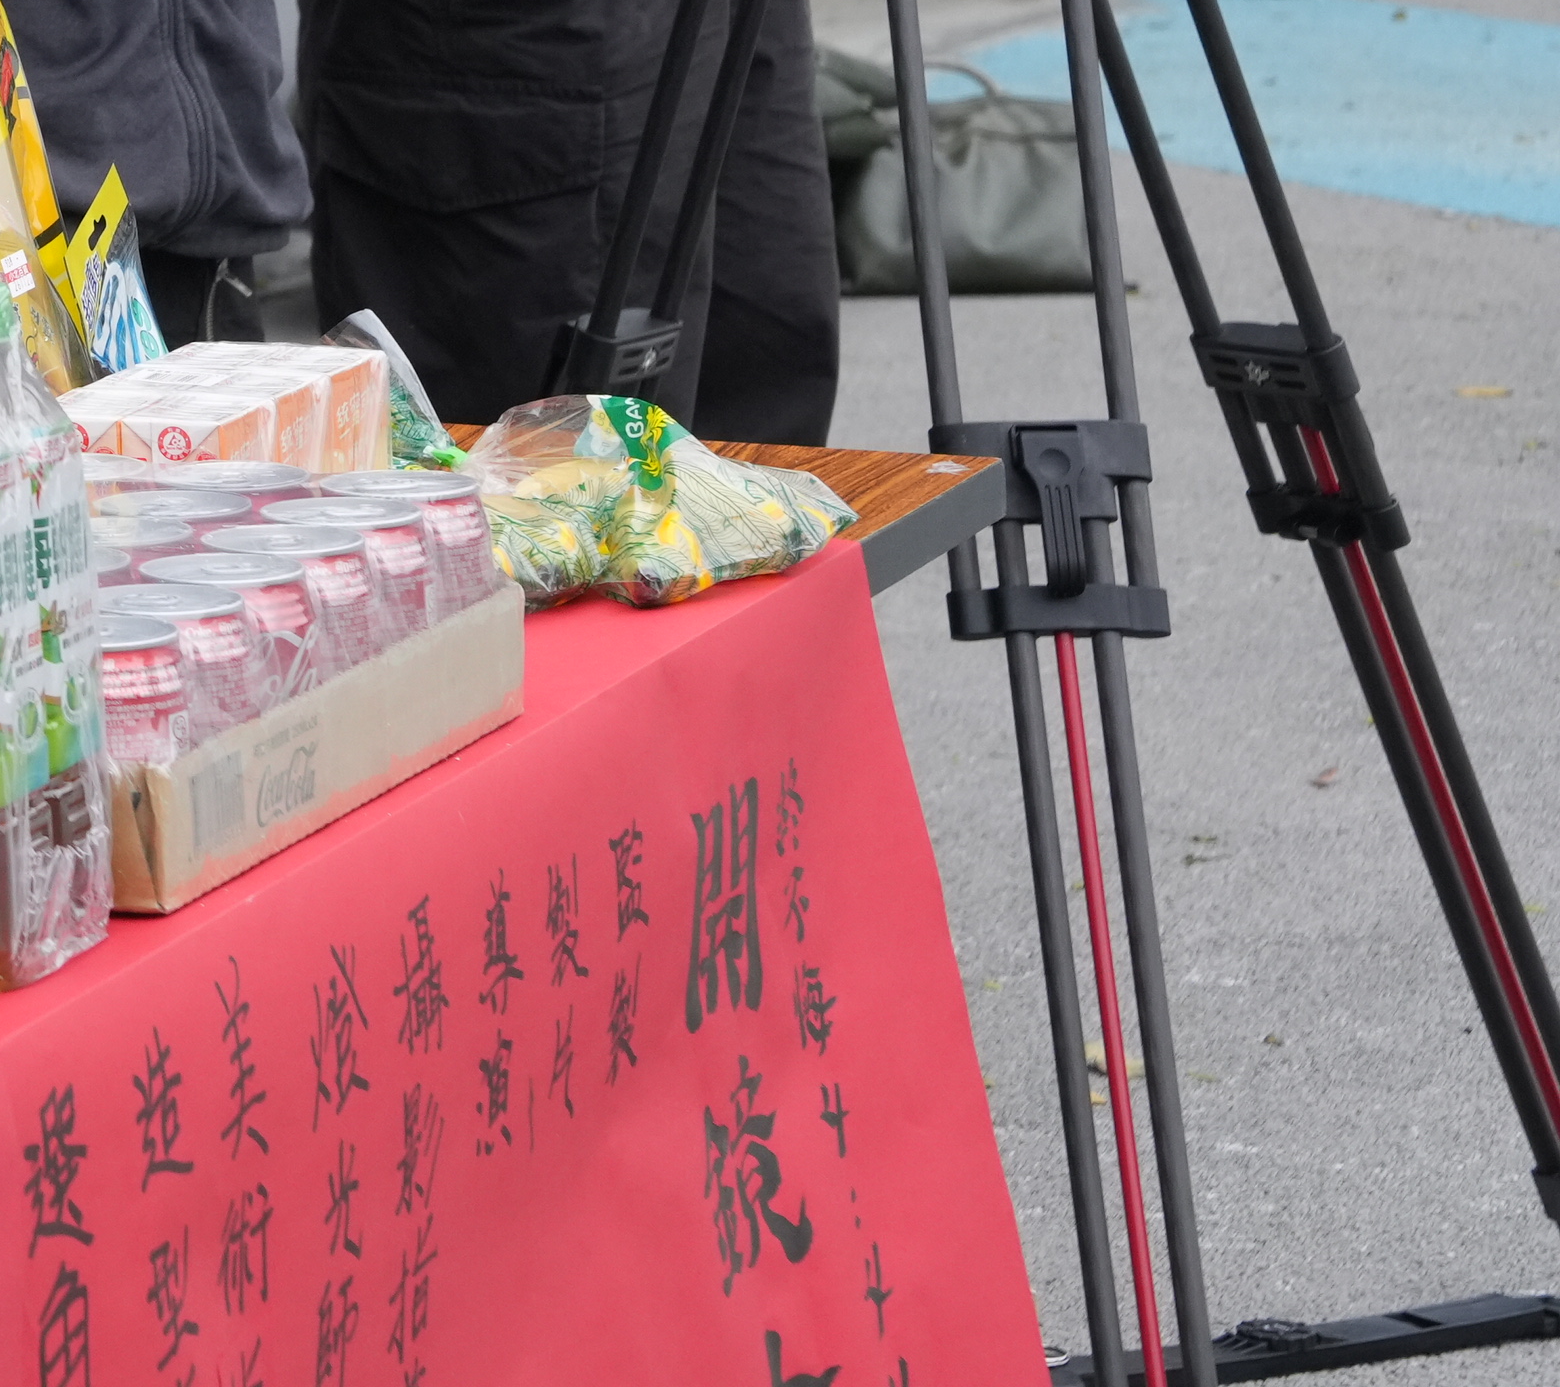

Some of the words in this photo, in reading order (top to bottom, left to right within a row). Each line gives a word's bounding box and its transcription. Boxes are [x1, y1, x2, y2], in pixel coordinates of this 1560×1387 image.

[625, 397, 645, 439] BA
[545, 853, 590, 1119] 製片
[604, 818, 650, 1088] 監製
[132, 1024, 201, 1387] 造型
